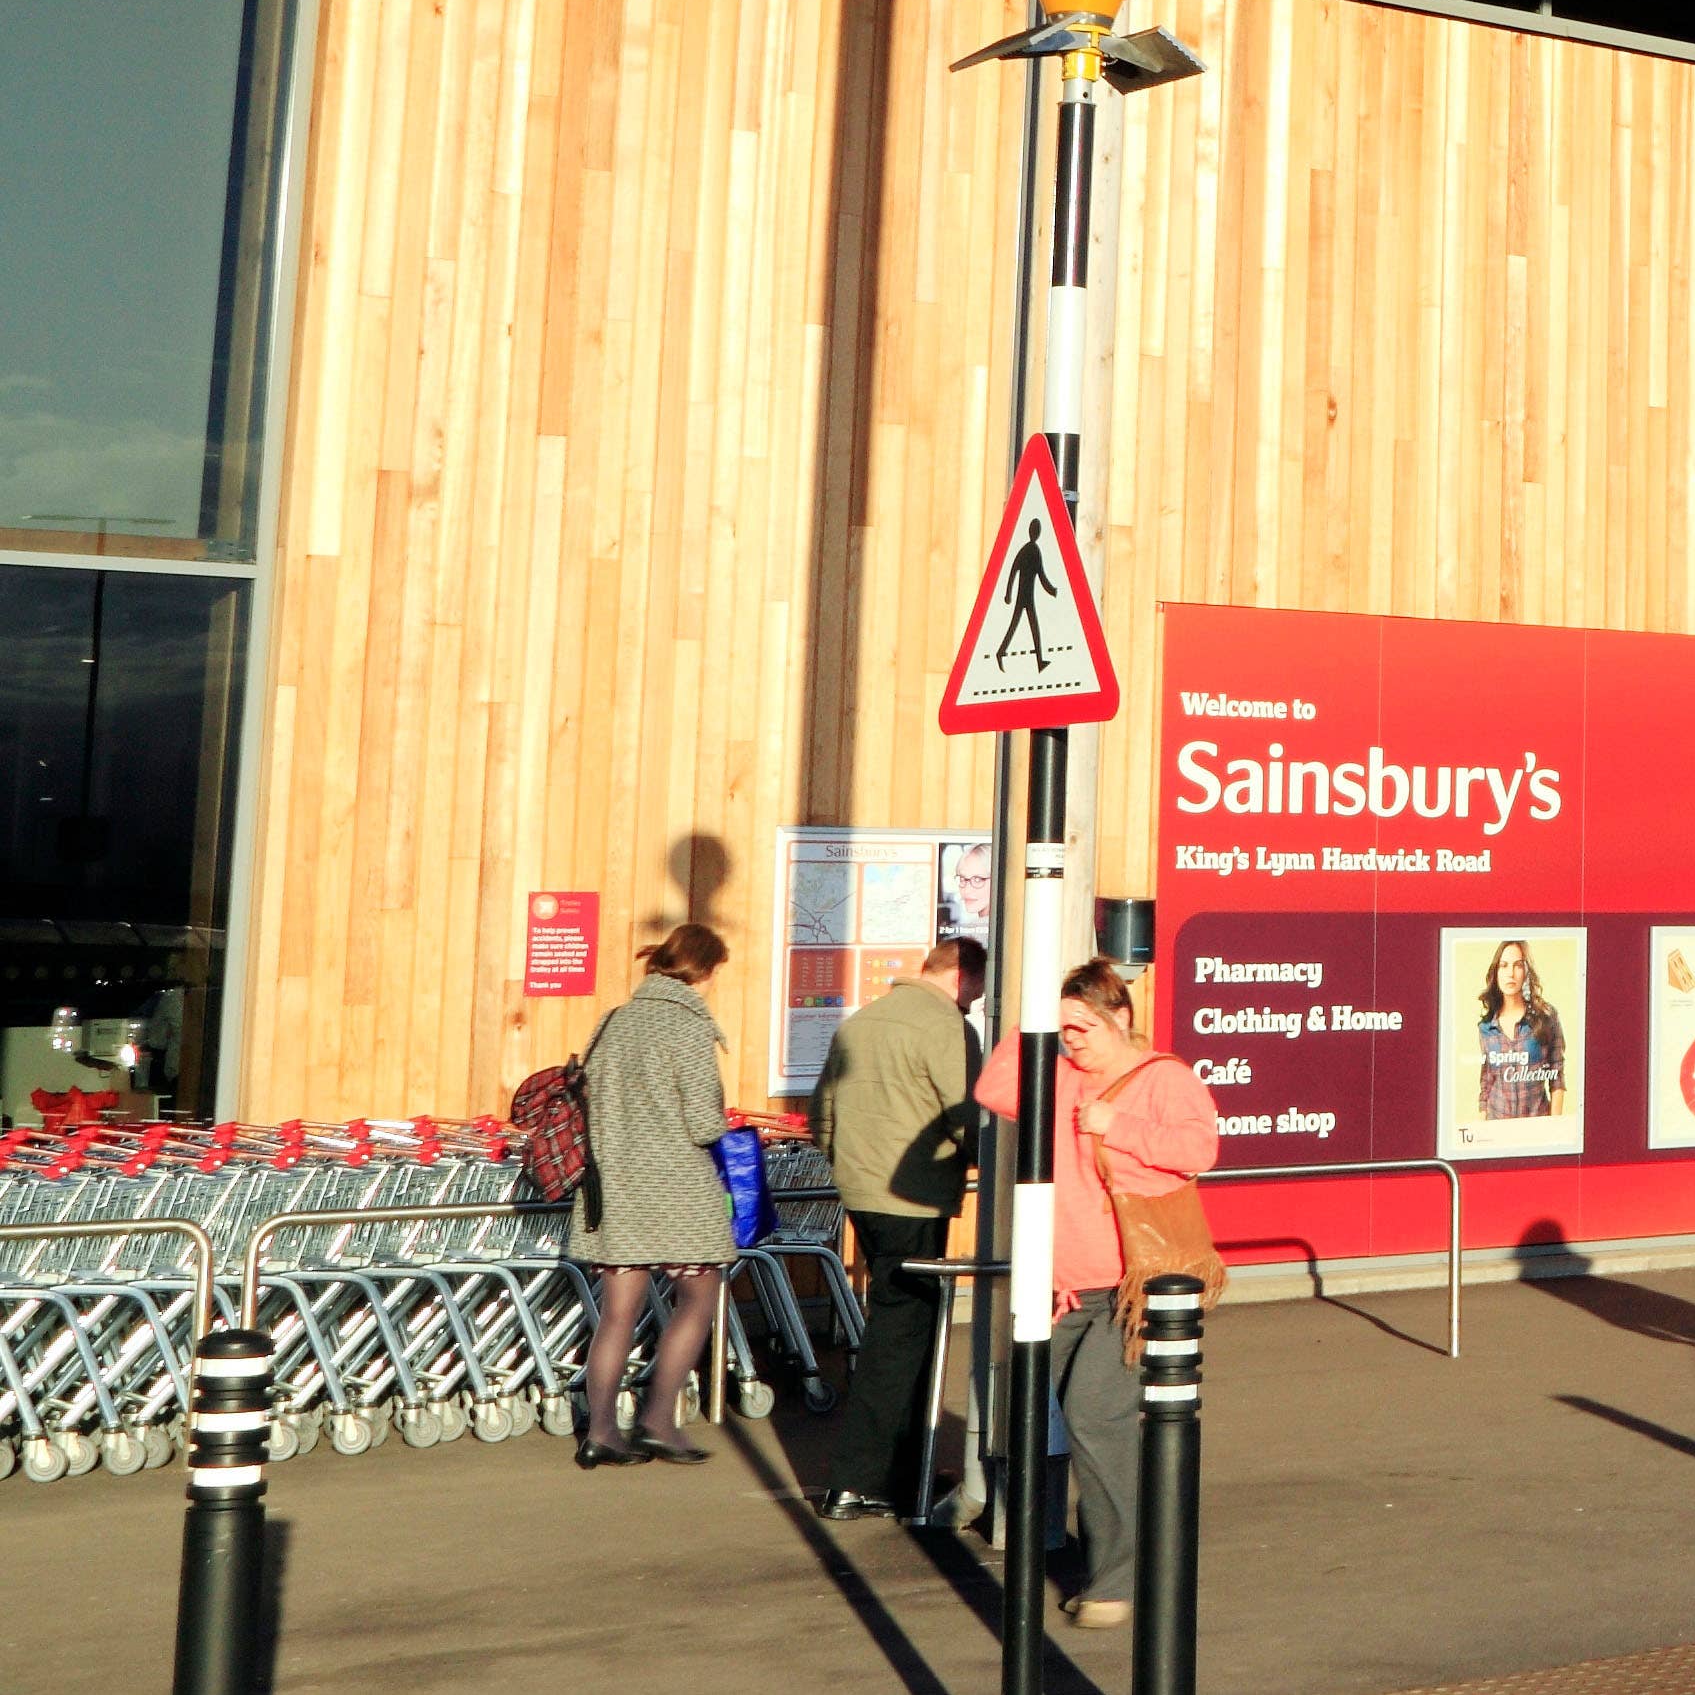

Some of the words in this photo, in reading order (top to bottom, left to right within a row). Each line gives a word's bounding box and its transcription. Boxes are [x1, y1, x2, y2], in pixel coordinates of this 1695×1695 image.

[1181, 692, 1287, 719] Welcome
[1293, 699, 1316, 720] to
[1177, 740, 1561, 835] Sainsbury's
[1175, 845, 1250, 875] King's
[1255, 846, 1315, 876] Lynn
[1321, 847, 1431, 872] Hardwick
[1435, 849, 1492, 872] Road
[1194, 956, 1324, 988] Pharmacy
[1193, 1007, 1302, 1038] Clothing
[1306, 1006, 1326, 1031] &
[1331, 1005, 1403, 1031] Home
[1193, 1058, 1252, 1085] Café
[1489, 1050, 1529, 1066] Spring
[1503, 1064, 1559, 1083] Collection
[1216, 1108, 1272, 1136] hone
[1276, 1107, 1336, 1138] shop
[1459, 1128, 1474, 1143] Tu
